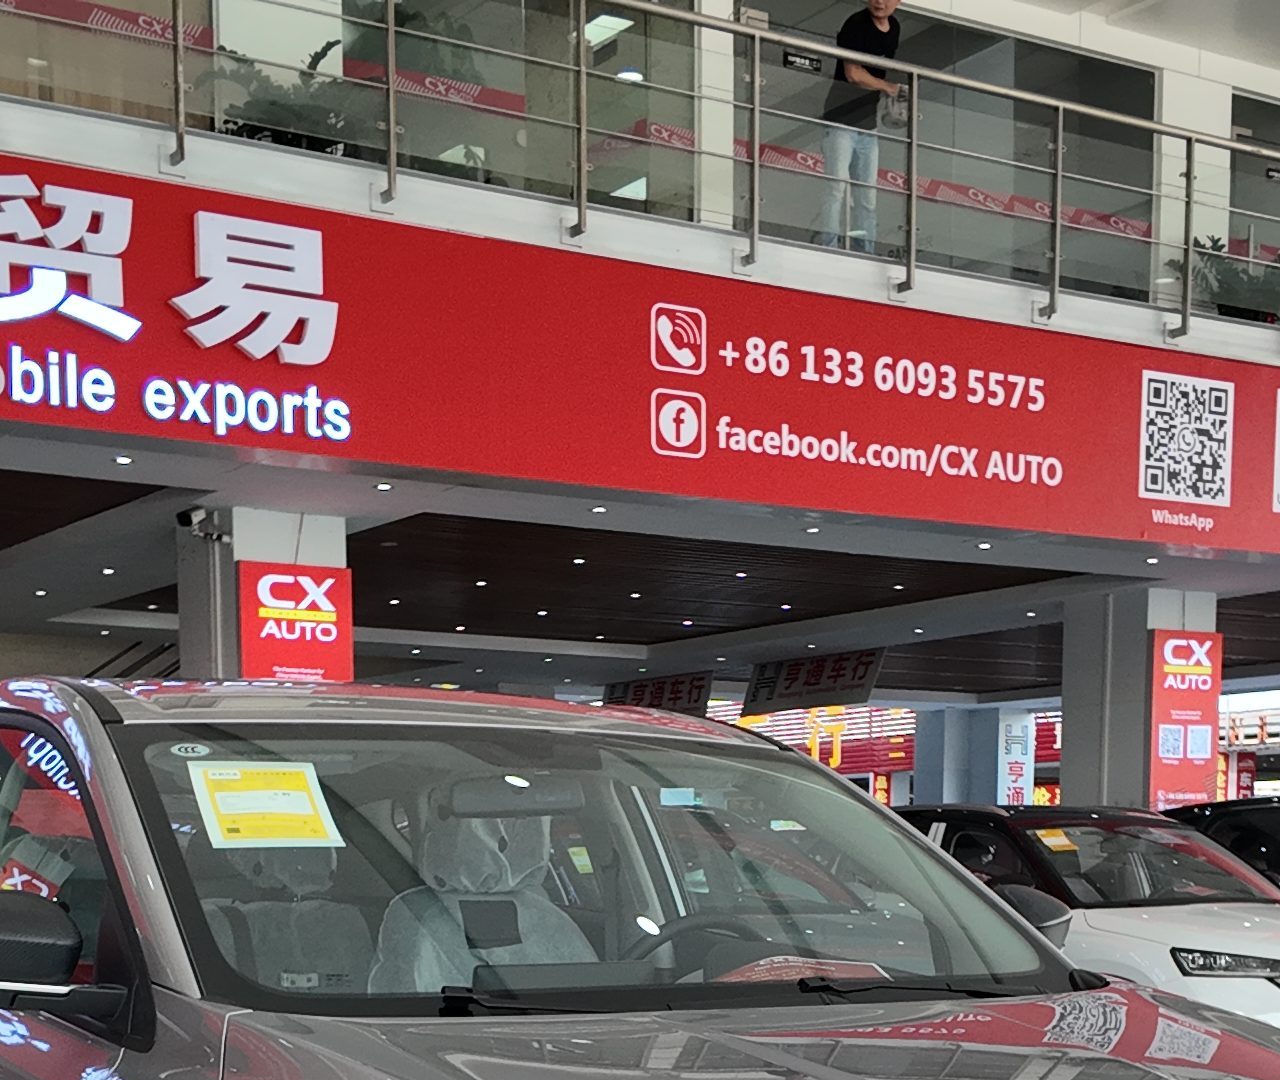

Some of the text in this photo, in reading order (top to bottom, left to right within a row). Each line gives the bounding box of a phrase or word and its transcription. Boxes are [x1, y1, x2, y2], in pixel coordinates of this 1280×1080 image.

[424, 77, 446, 95] CX
[650, 124, 670, 140] CX
[796, 153, 815, 168] CX
[718, 337, 1046, 412] +86 133 6093 5575
[142, 376, 353, 442] exports
[716, 416, 1064, 487] facebook.com/CX AUTO
[1151, 509, 1215, 532] WhatsApp
[257, 574, 337, 612] CX
[260, 619, 338, 642] AUTO
[1164, 639, 1213, 667] CX
[1164, 674, 1212, 691] AUTO
